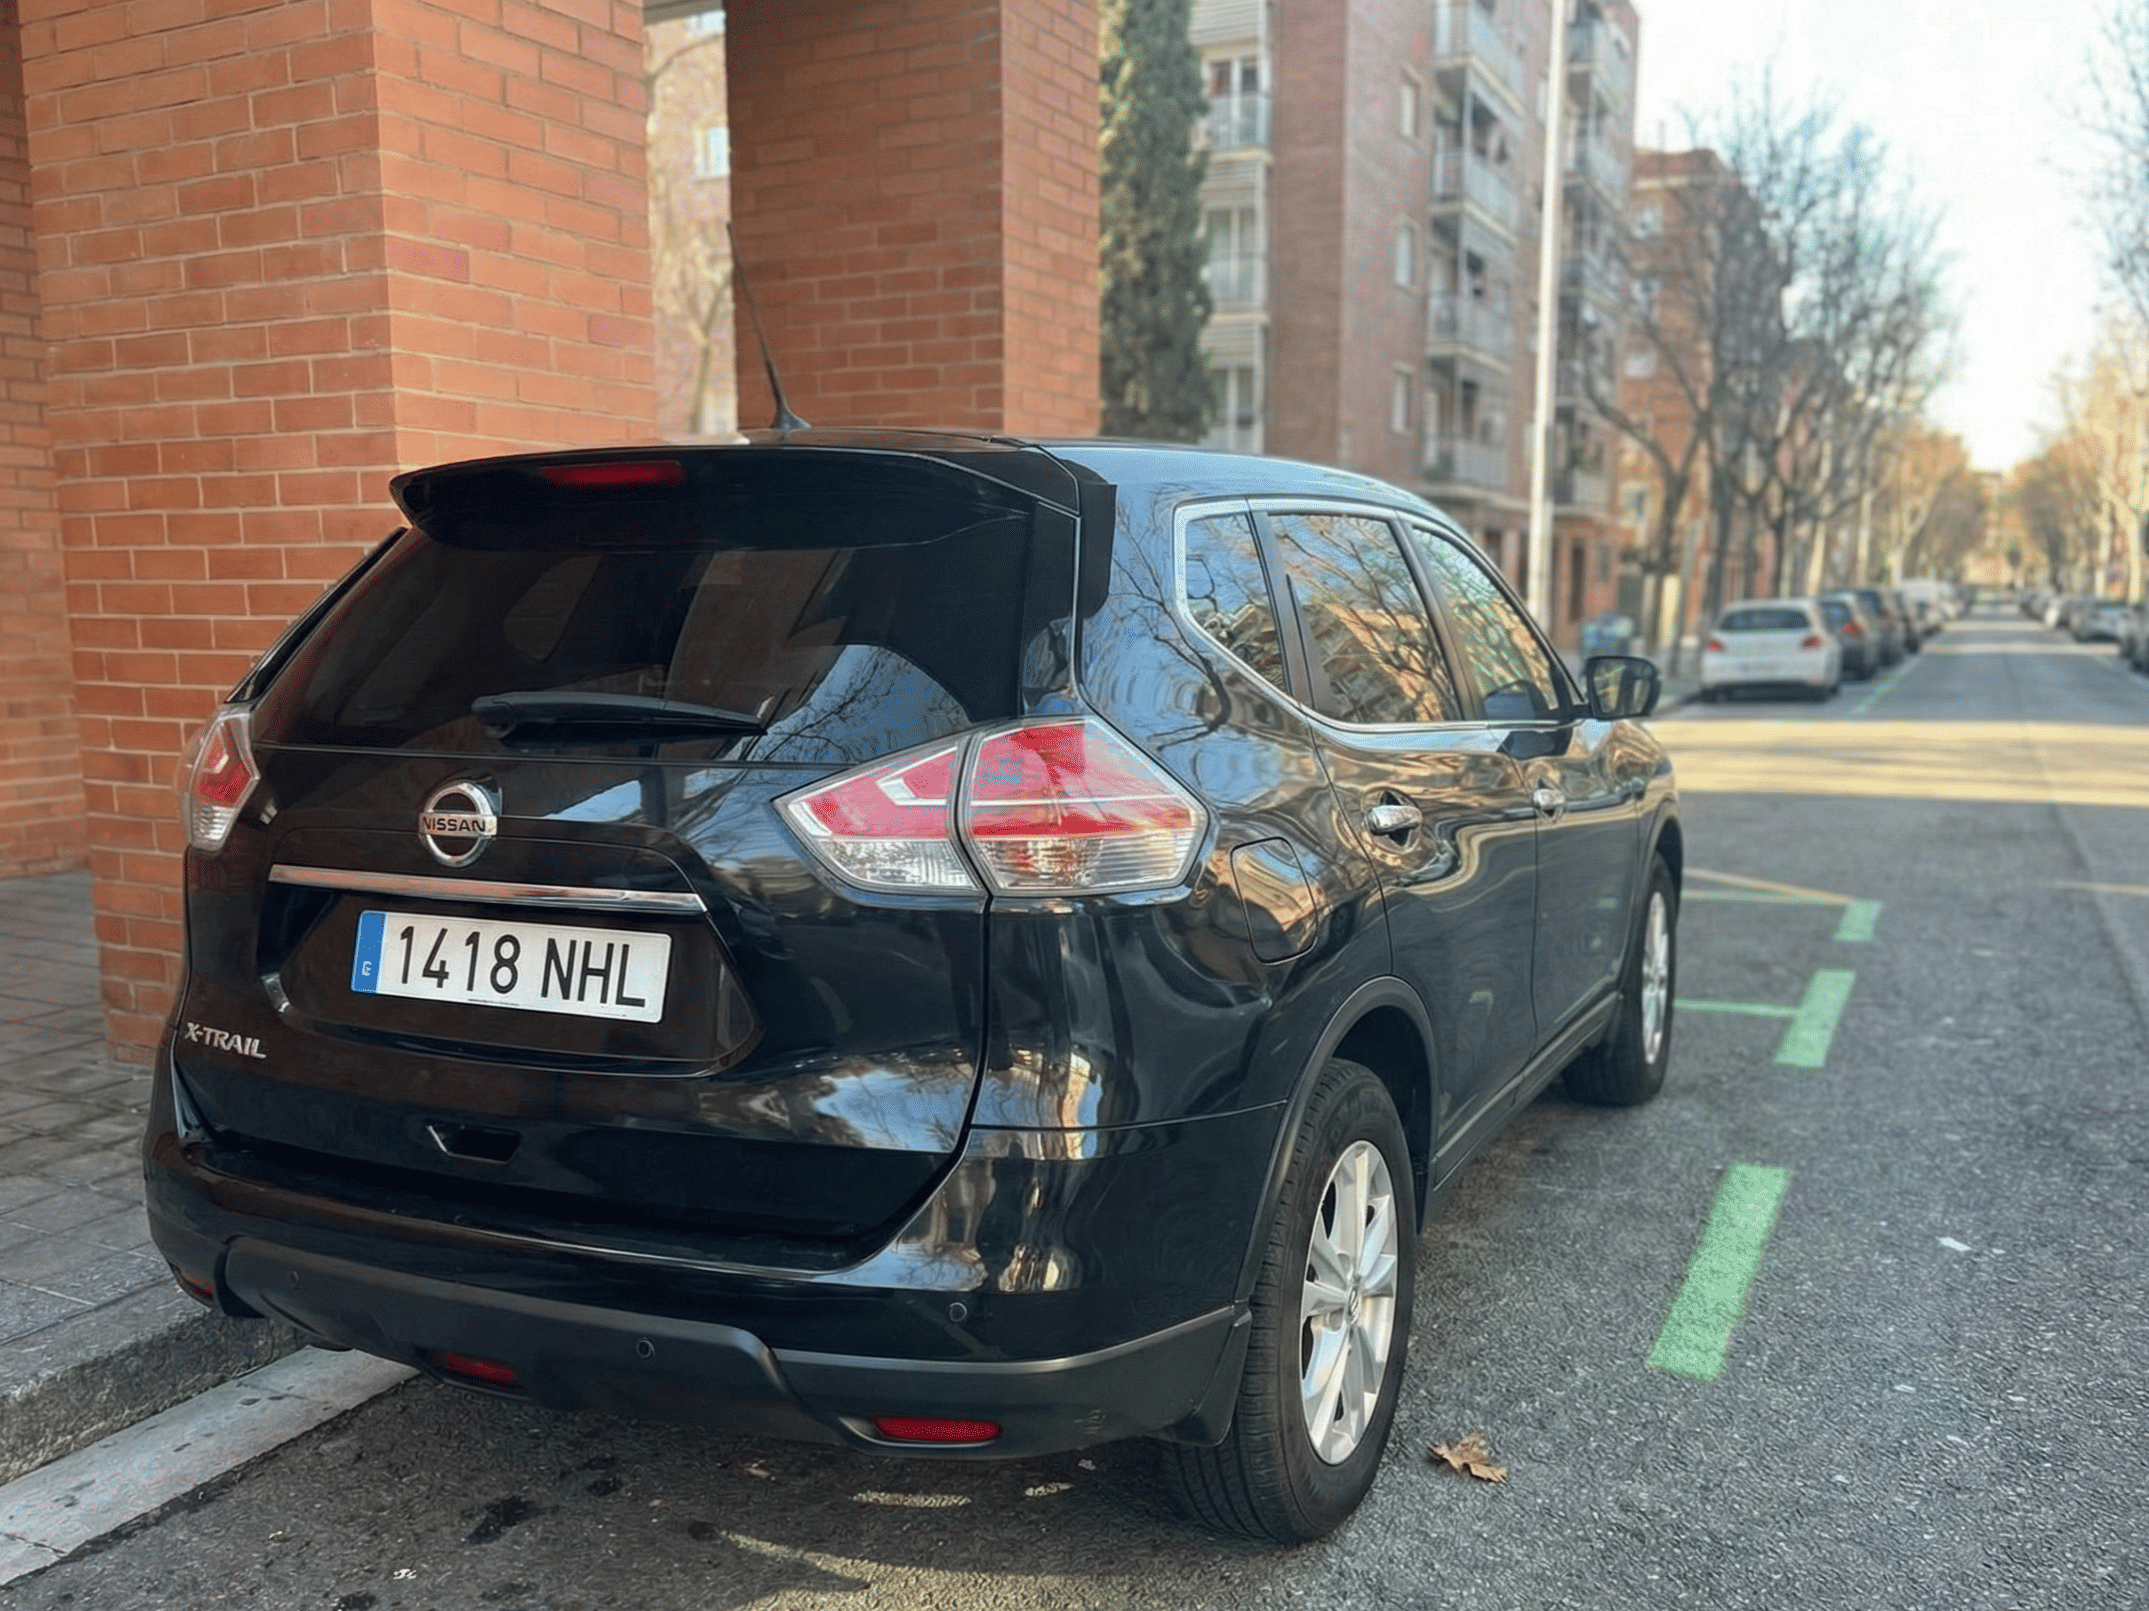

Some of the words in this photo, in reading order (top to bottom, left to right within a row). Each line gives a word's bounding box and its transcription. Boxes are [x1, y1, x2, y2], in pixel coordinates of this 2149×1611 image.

[423, 816, 485, 832] NISSAN
[400, 926, 521, 995] 1418
[541, 938, 646, 1008] NHL
[184, 1022, 267, 1059] X-TRAIL
